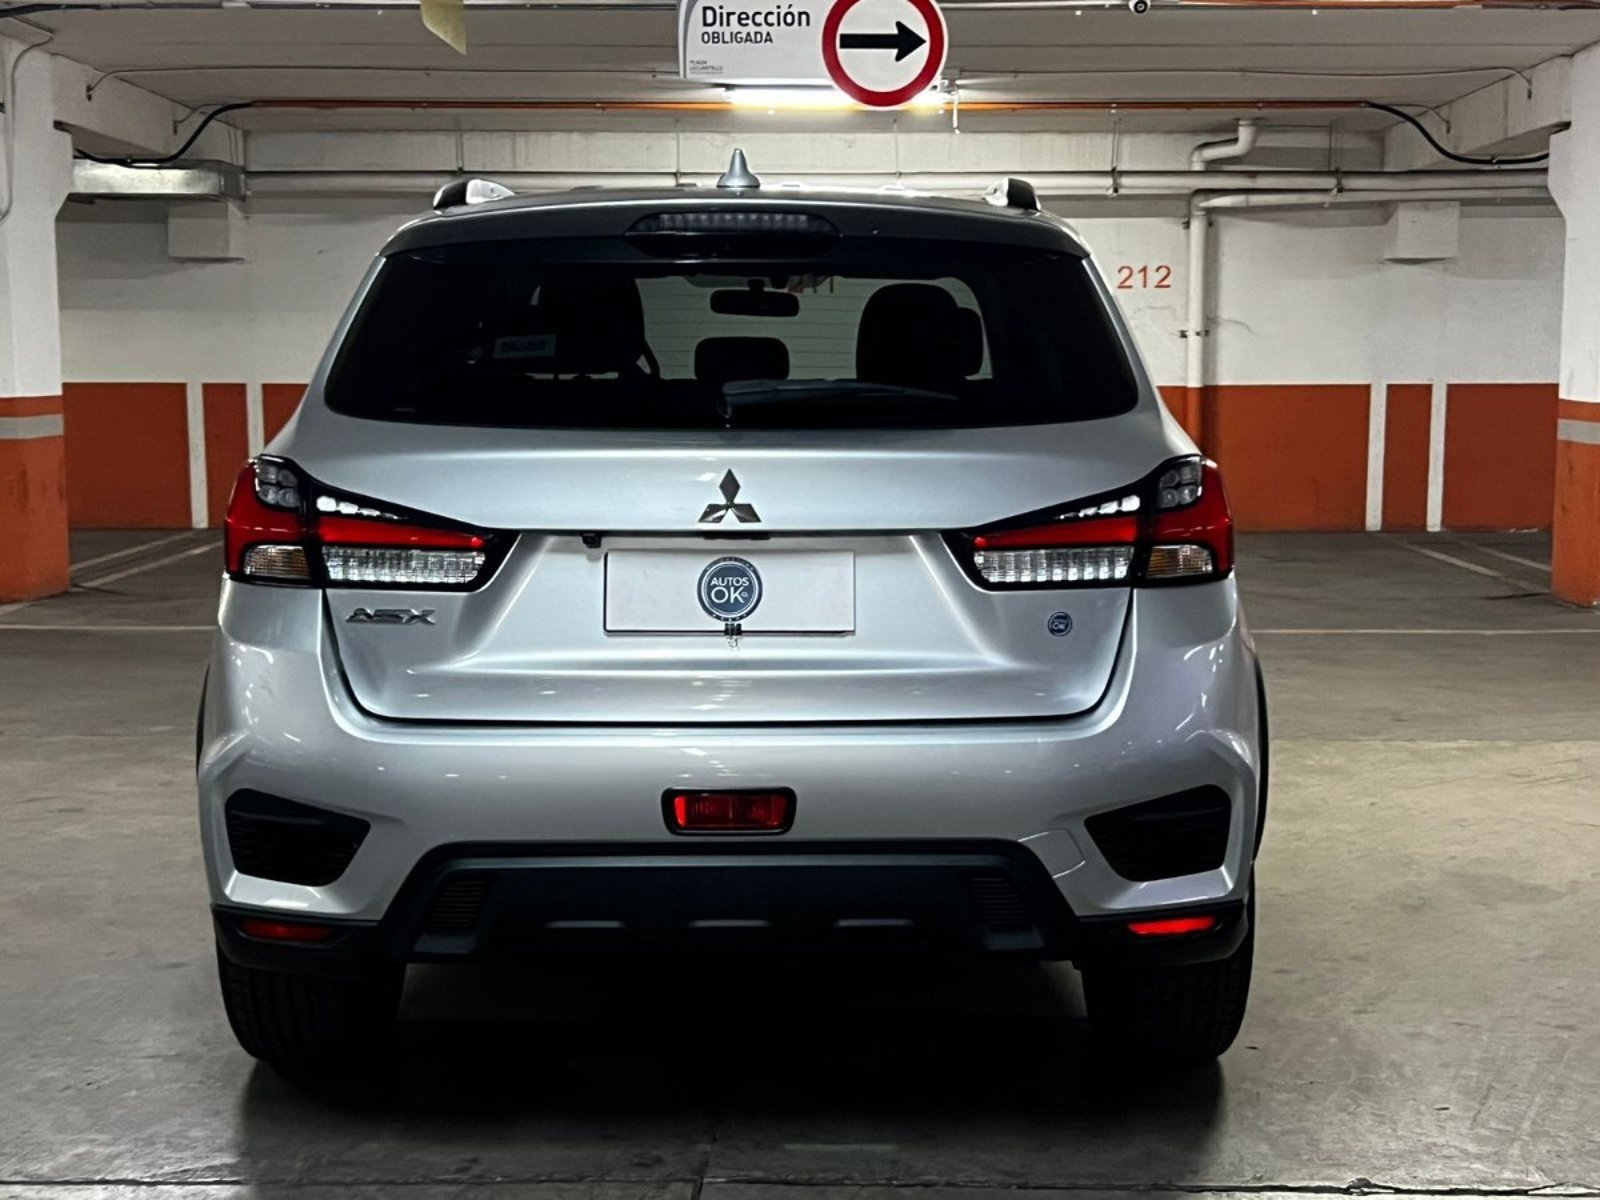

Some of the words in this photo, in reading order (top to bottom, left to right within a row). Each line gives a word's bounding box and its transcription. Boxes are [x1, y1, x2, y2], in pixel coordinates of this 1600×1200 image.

[702, 5, 811, 27] Dirección
[701, 31, 774, 44] OBLIGADA
[1116, 265, 1172, 289] 212
[710, 577, 749, 586] AUTOS
[711, 586, 745, 604] OK
[346, 608, 436, 625] ASX
